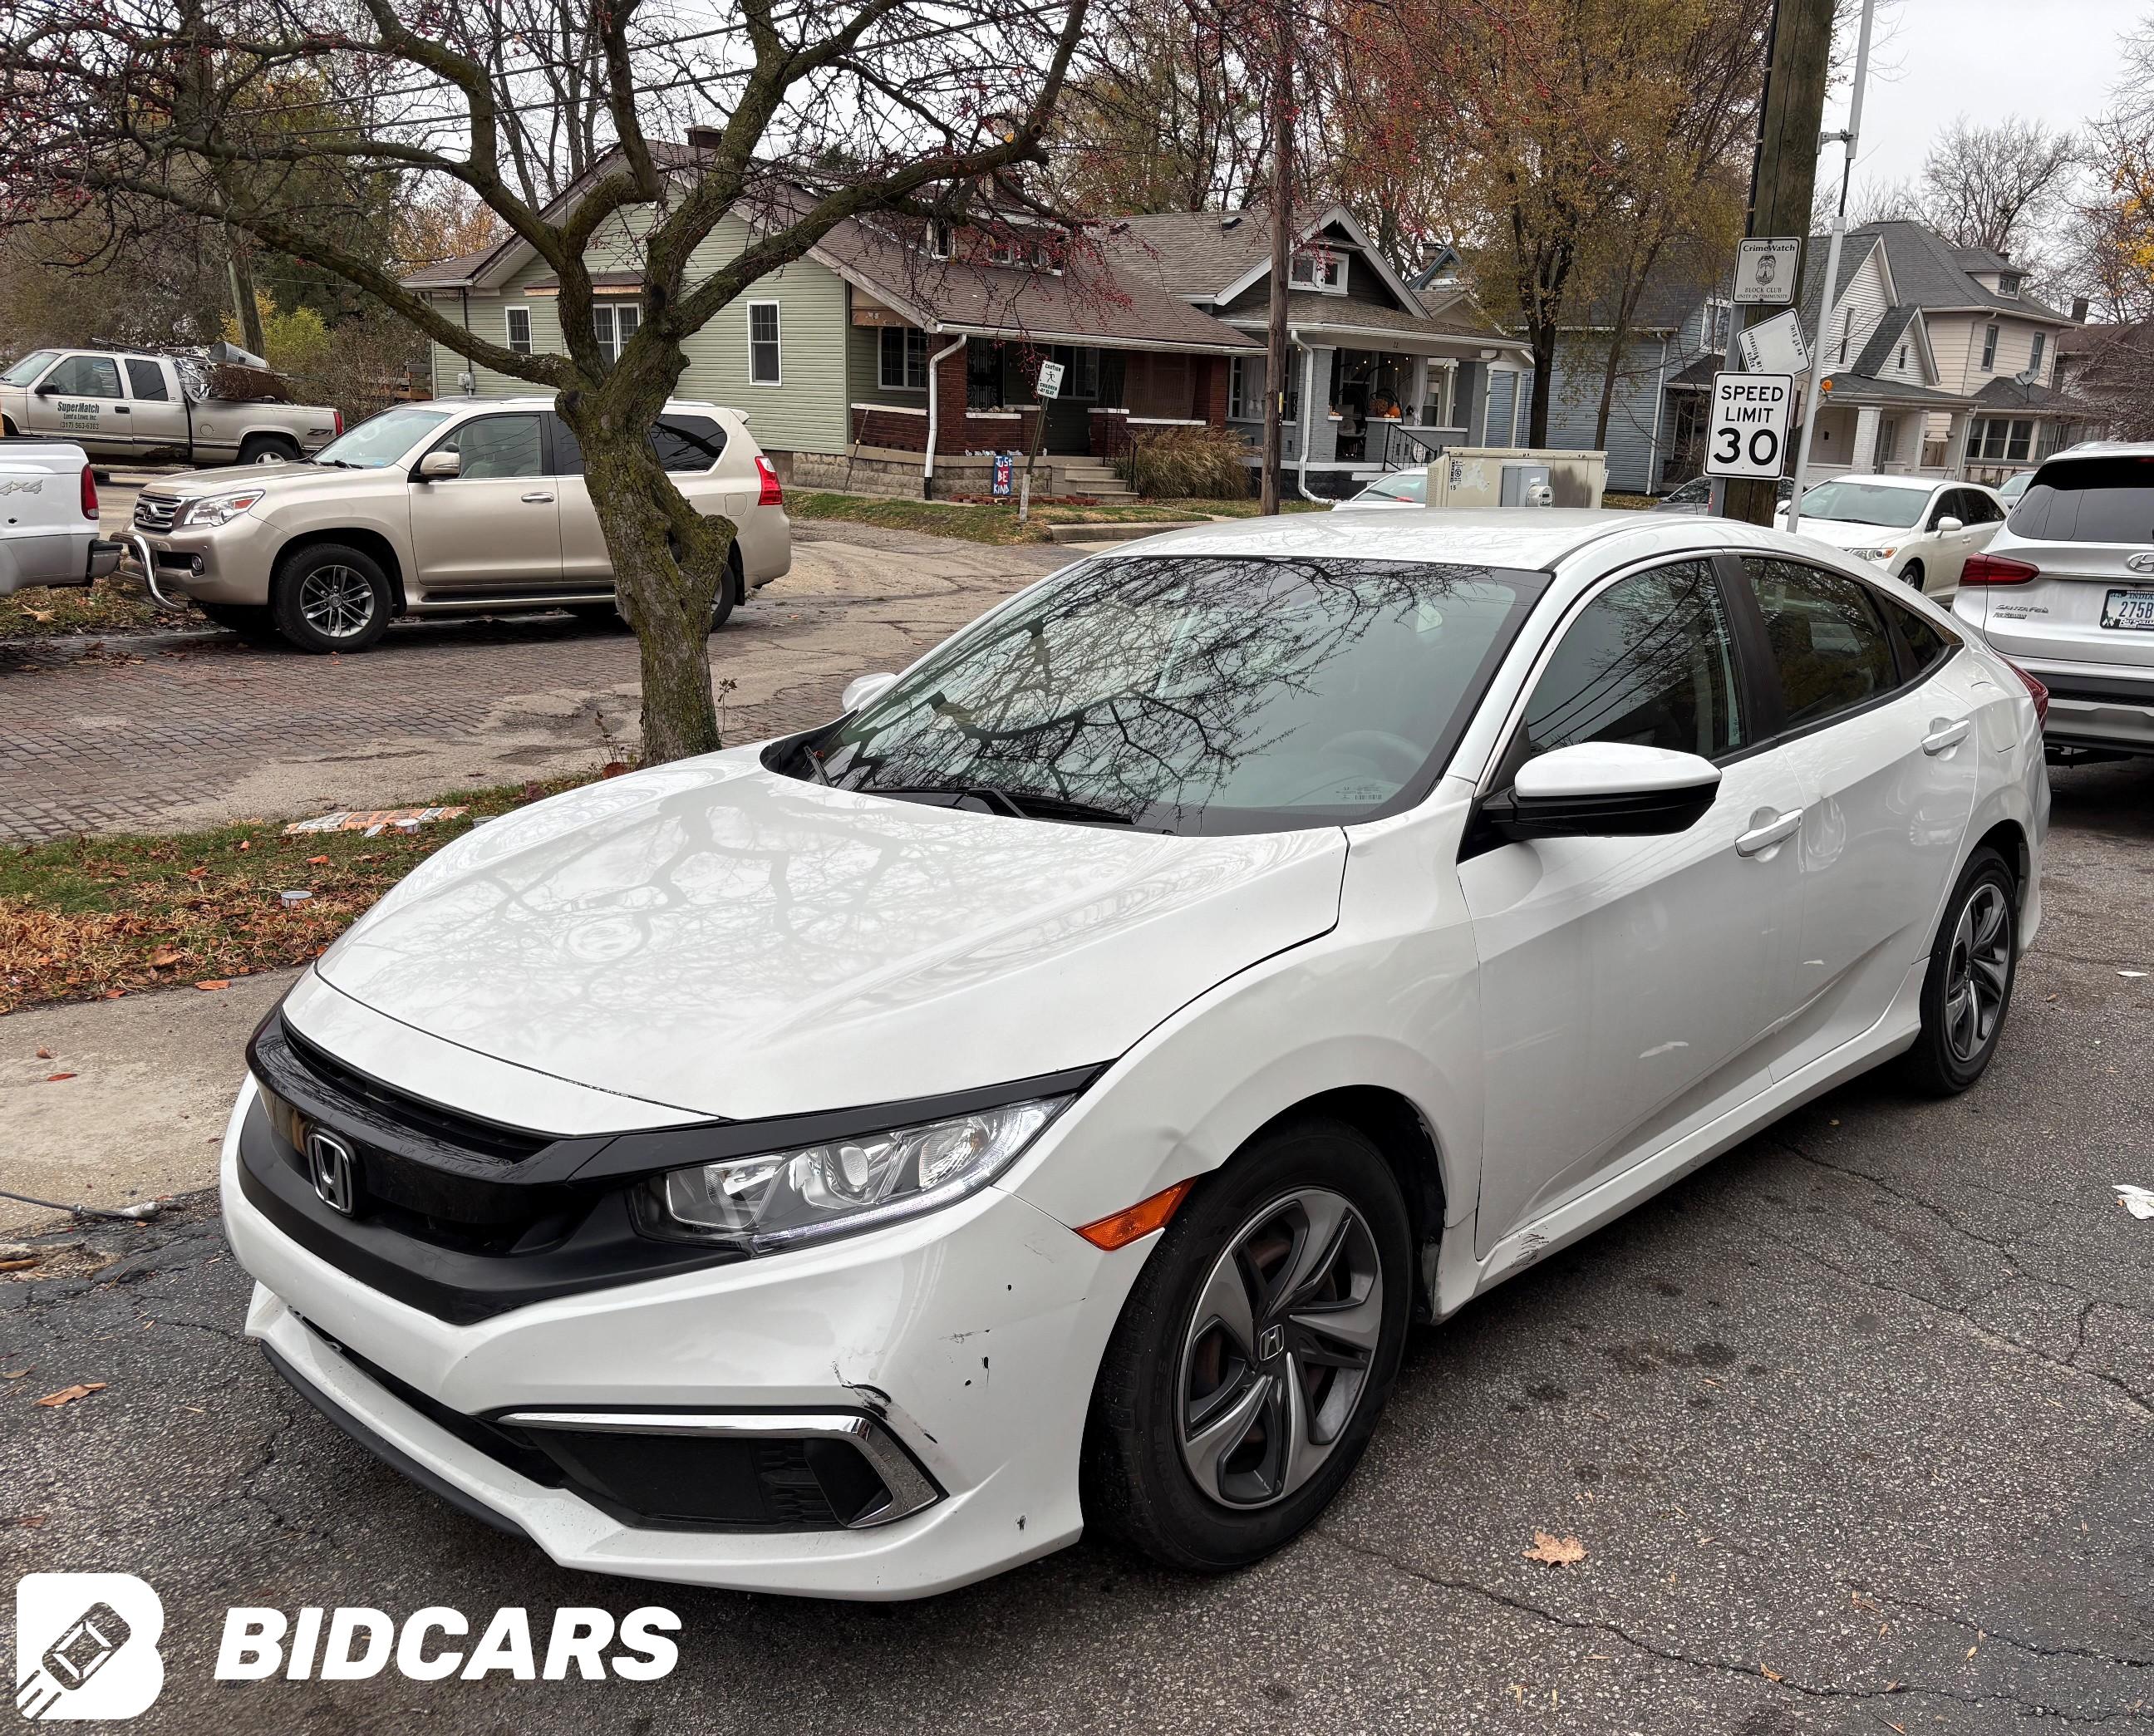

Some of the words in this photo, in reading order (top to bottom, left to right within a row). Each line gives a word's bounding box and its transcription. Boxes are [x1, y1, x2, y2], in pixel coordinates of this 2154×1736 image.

[1045, 363, 1061, 372] CAUTION
[1721, 386, 1783, 401] SPEED
[57, 401, 100, 414] SuperMatch
[1725, 406, 1773, 423] LIMIT
[1713, 427, 1778, 465] 30
[997, 470, 1009, 482] BE
[993, 483, 1010, 494] KIND
